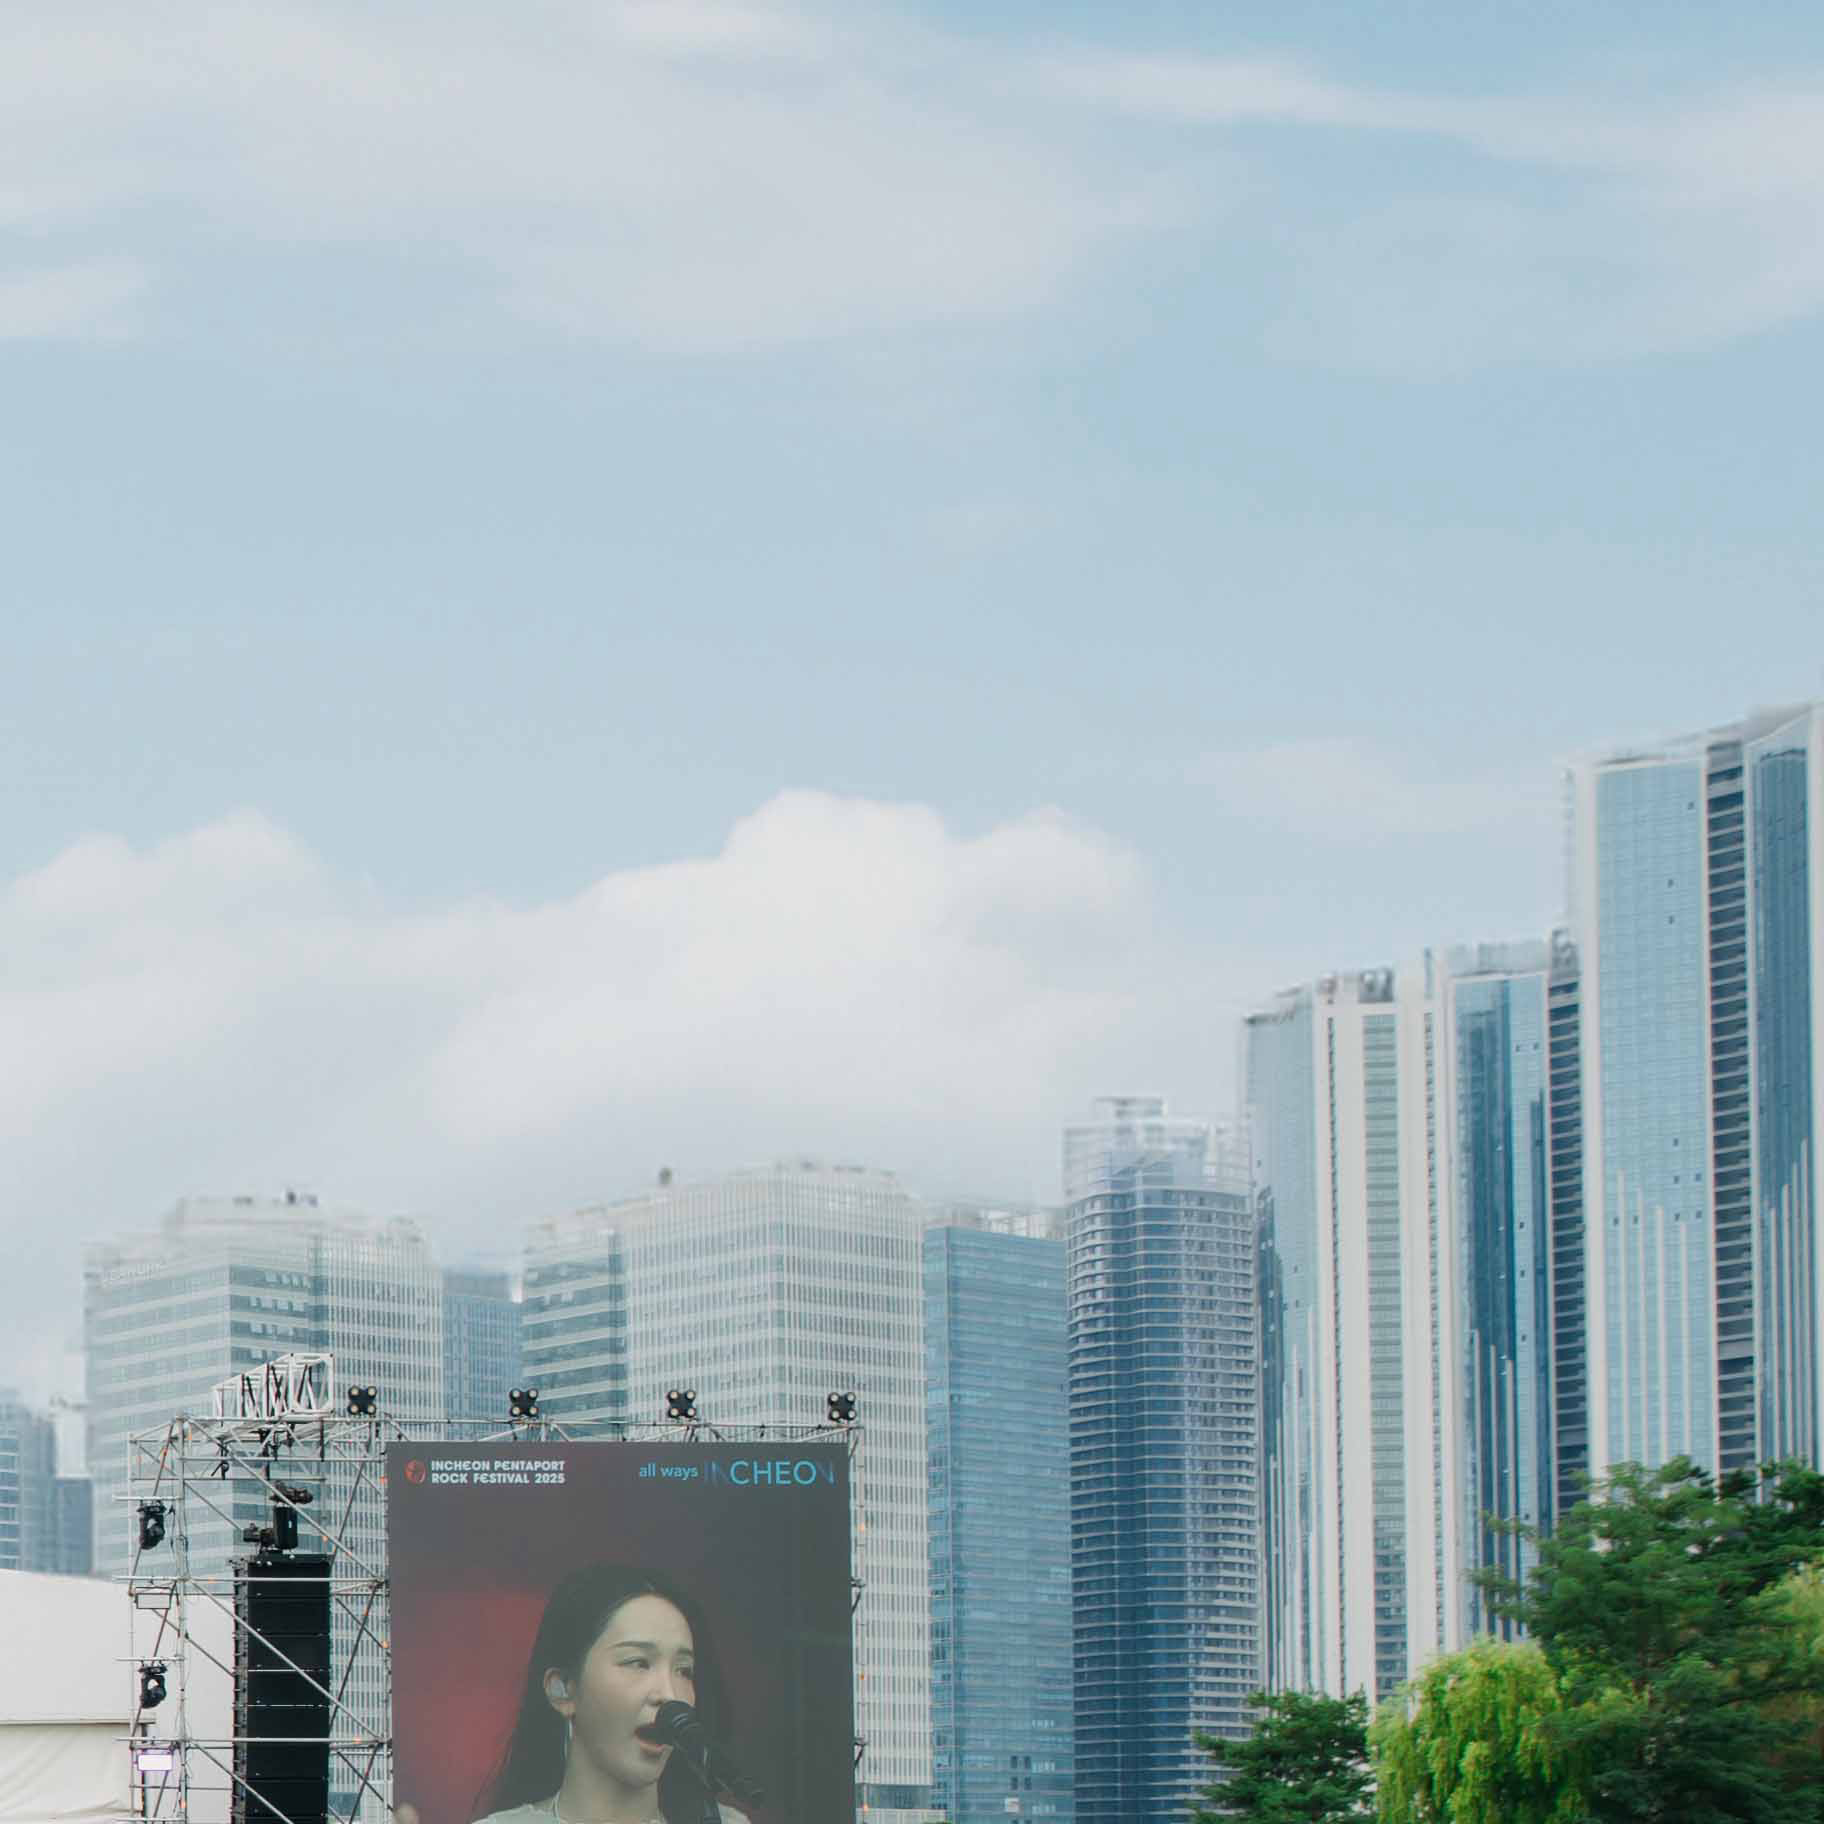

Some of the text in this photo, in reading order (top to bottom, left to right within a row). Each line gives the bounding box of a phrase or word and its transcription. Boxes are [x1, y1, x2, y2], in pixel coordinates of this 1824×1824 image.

[431, 1460, 565, 1471] INCHEON PENTAPORT
[639, 1463, 656, 1477] all
[659, 1465, 698, 1480] ways
[431, 1473, 565, 1484] ROCK FESTIVAL 2025
